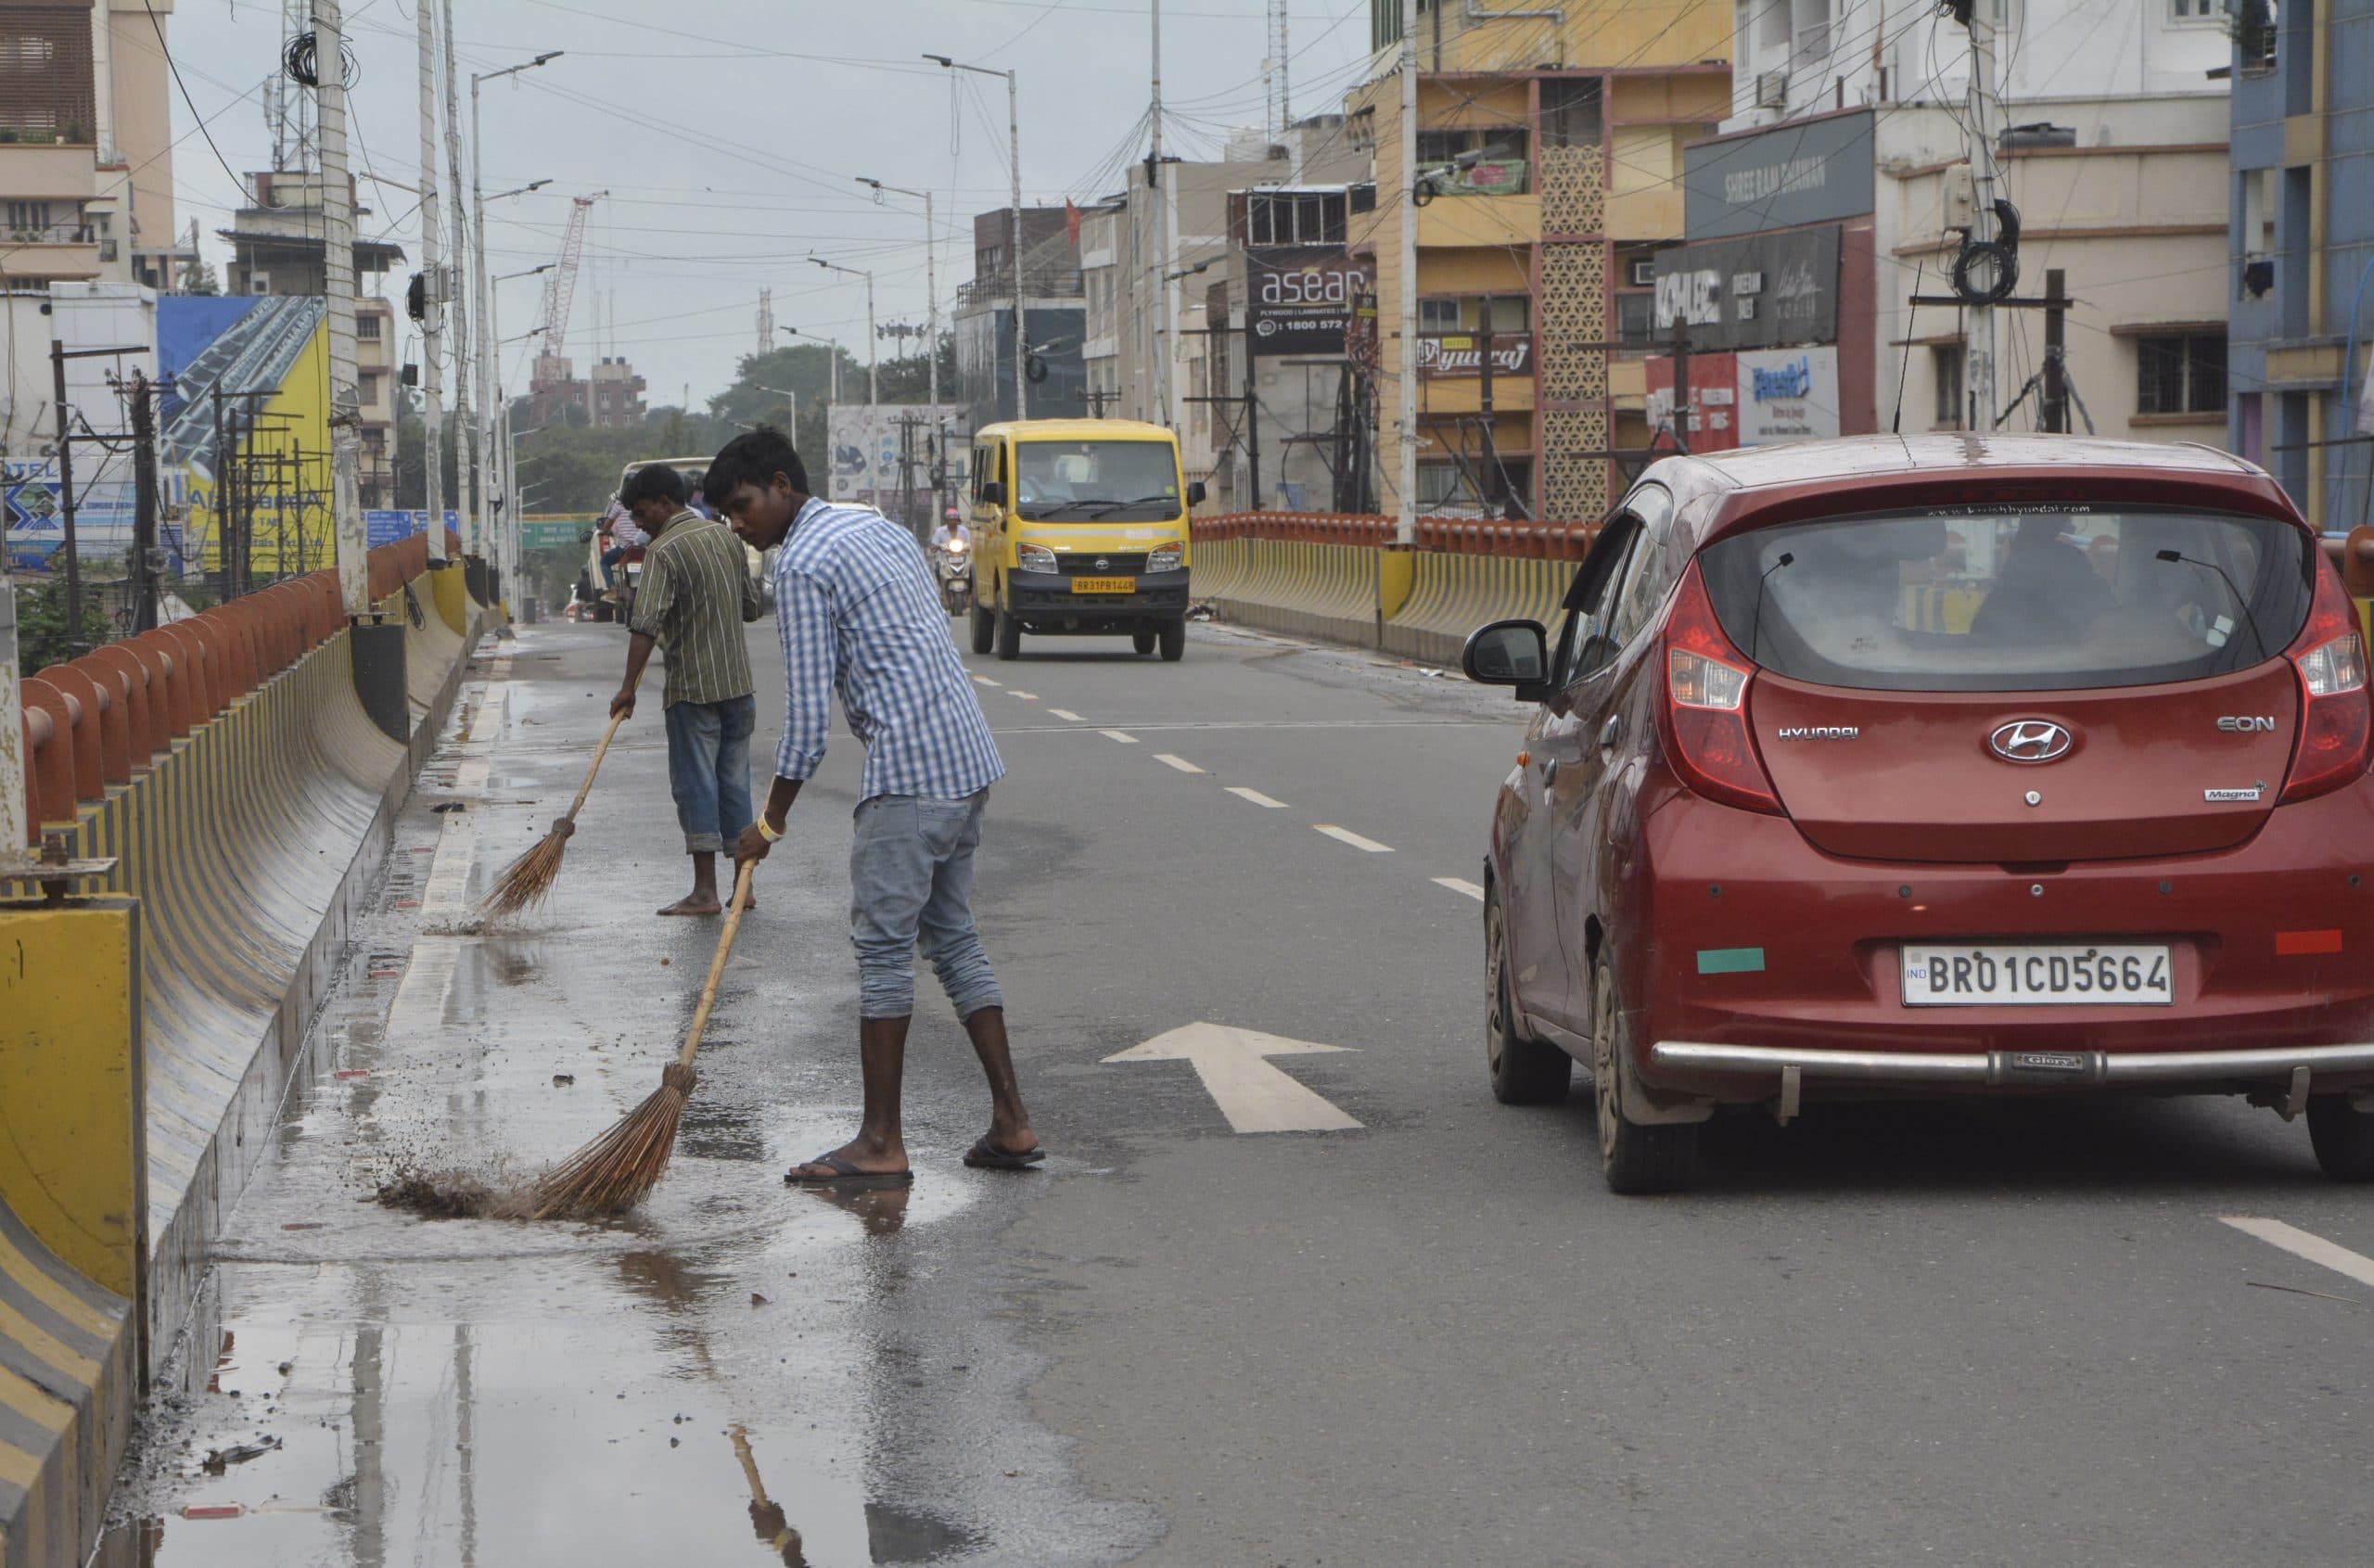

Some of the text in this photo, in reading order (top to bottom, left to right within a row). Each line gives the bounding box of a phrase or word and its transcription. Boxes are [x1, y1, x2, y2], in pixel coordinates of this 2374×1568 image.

[1286, 321, 1316, 330] 1800
[1321, 320, 1343, 329] 572
[2217, 716, 2275, 733] EON
[1779, 726, 1859, 741] HYUNDAI
[2209, 791, 2256, 800] Magna
[1907, 956, 2167, 992] IND BR01CD5664
[2028, 1056, 2071, 1066] Glory
